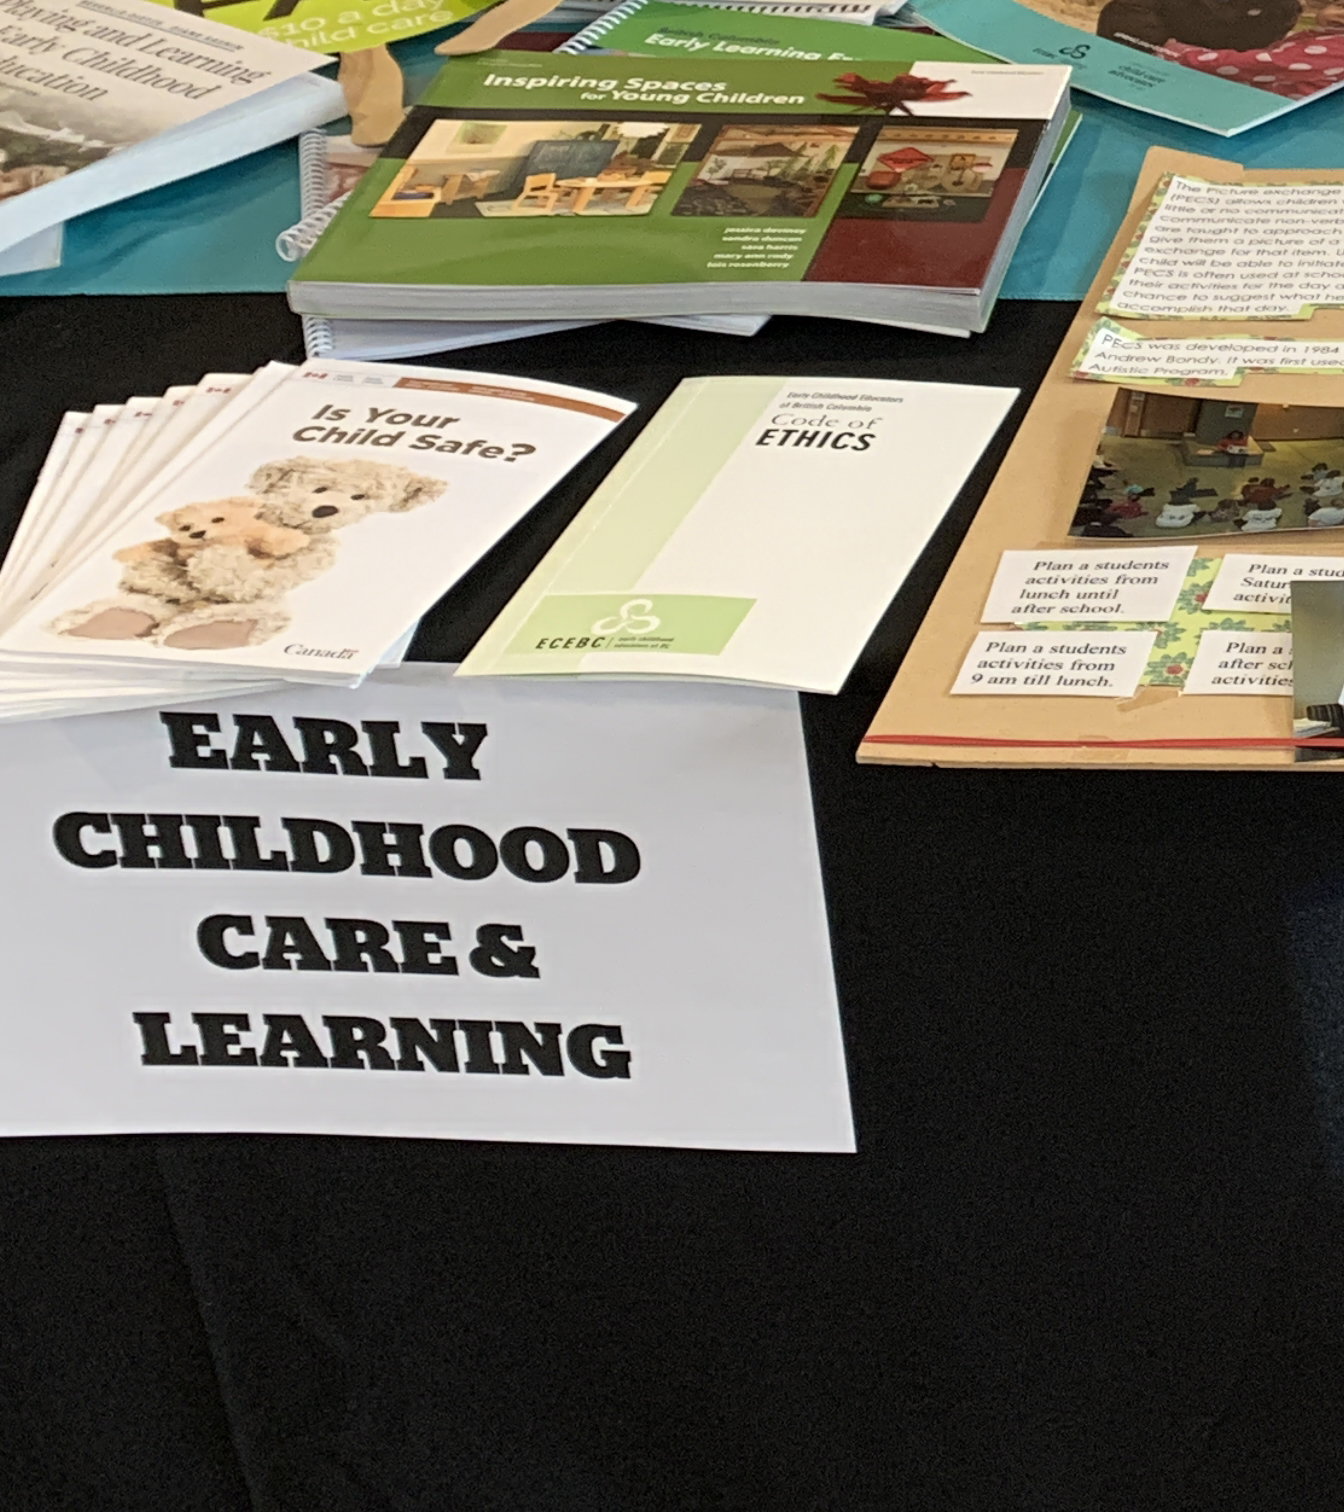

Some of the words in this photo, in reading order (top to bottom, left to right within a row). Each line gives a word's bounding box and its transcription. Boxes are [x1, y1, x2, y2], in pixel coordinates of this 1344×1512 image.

[645, 32, 710, 52] Early
[712, 41, 822, 61] Learning
[484, 73, 617, 90] Inspiring
[623, 77, 727, 92] Spaces
[581, 92, 606, 101] for
[612, 90, 690, 105] Young
[697, 92, 805, 105] Children
[1101, 334, 1142, 350] PECS
[1148, 342, 1181, 352] was
[1186, 341, 1278, 354] developed
[312, 403, 353, 424] Is
[356, 406, 459, 431] Your
[772, 413, 839, 427] Code
[848, 417, 883, 429] of
[292, 425, 405, 448] Child
[411, 432, 537, 463] Safe?
[755, 429, 876, 451] ETHICS
[1033, 560, 1073, 572] Plan
[1078, 562, 1089, 571] a
[1095, 559, 1169, 571] students
[1025, 574, 1110, 585] activities
[1115, 573, 1158, 585] from
[284, 642, 357, 663] Canada
[535, 636, 608, 650] ECEBC
[160, 710, 488, 781] EARLY
[53, 811, 641, 884] CHILDHOOD
[196, 914, 459, 977] CARE
[469, 922, 540, 979] &
[133, 1011, 631, 1080] LEARNING
